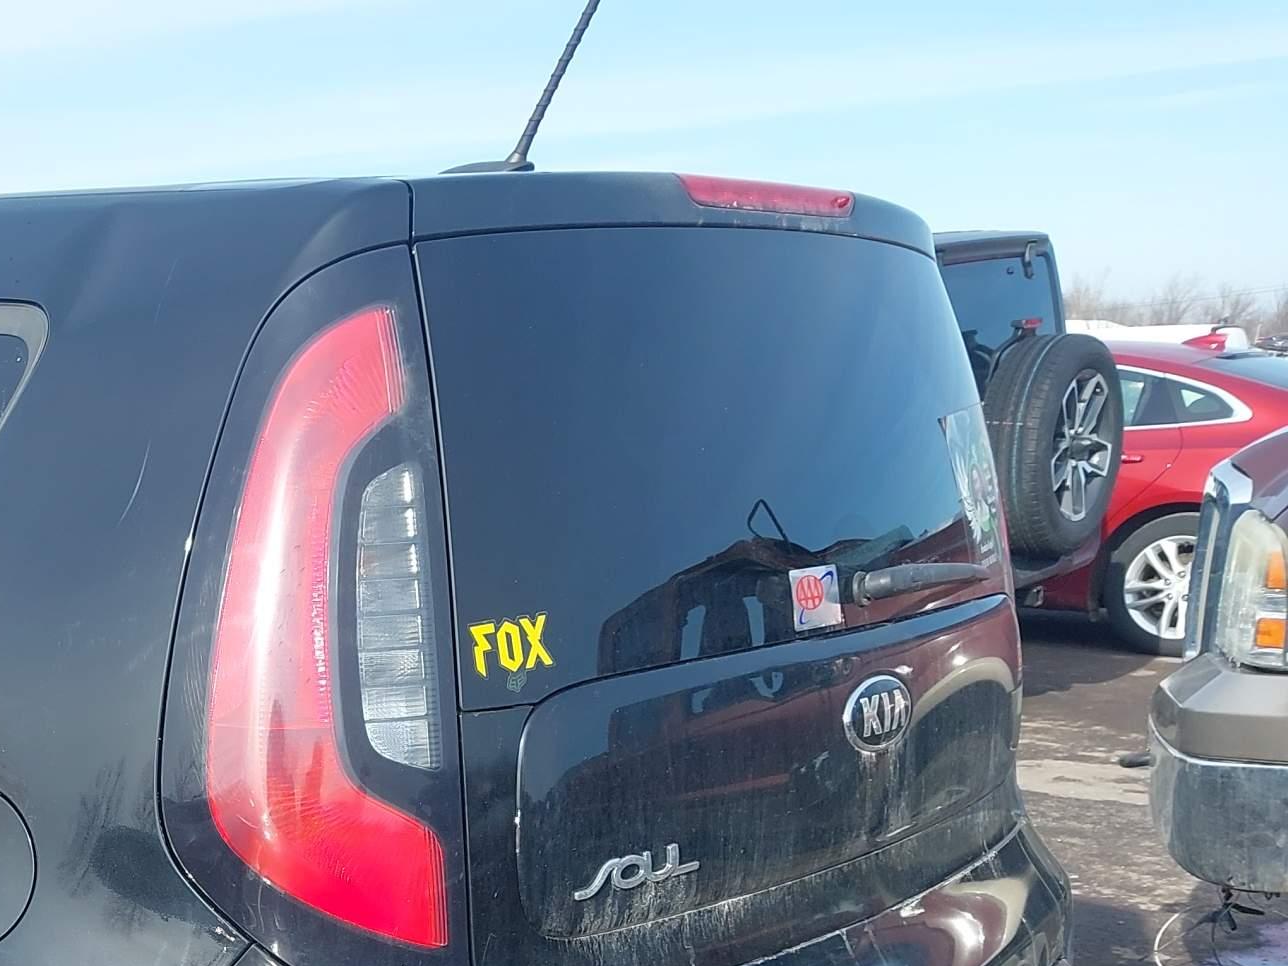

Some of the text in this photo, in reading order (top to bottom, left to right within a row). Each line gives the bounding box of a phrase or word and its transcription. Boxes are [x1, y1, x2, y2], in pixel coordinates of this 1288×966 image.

[796, 575, 824, 610] AAA
[469, 614, 553, 678] FOX
[859, 689, 906, 737] KIA
[574, 843, 700, 901] SOUL
